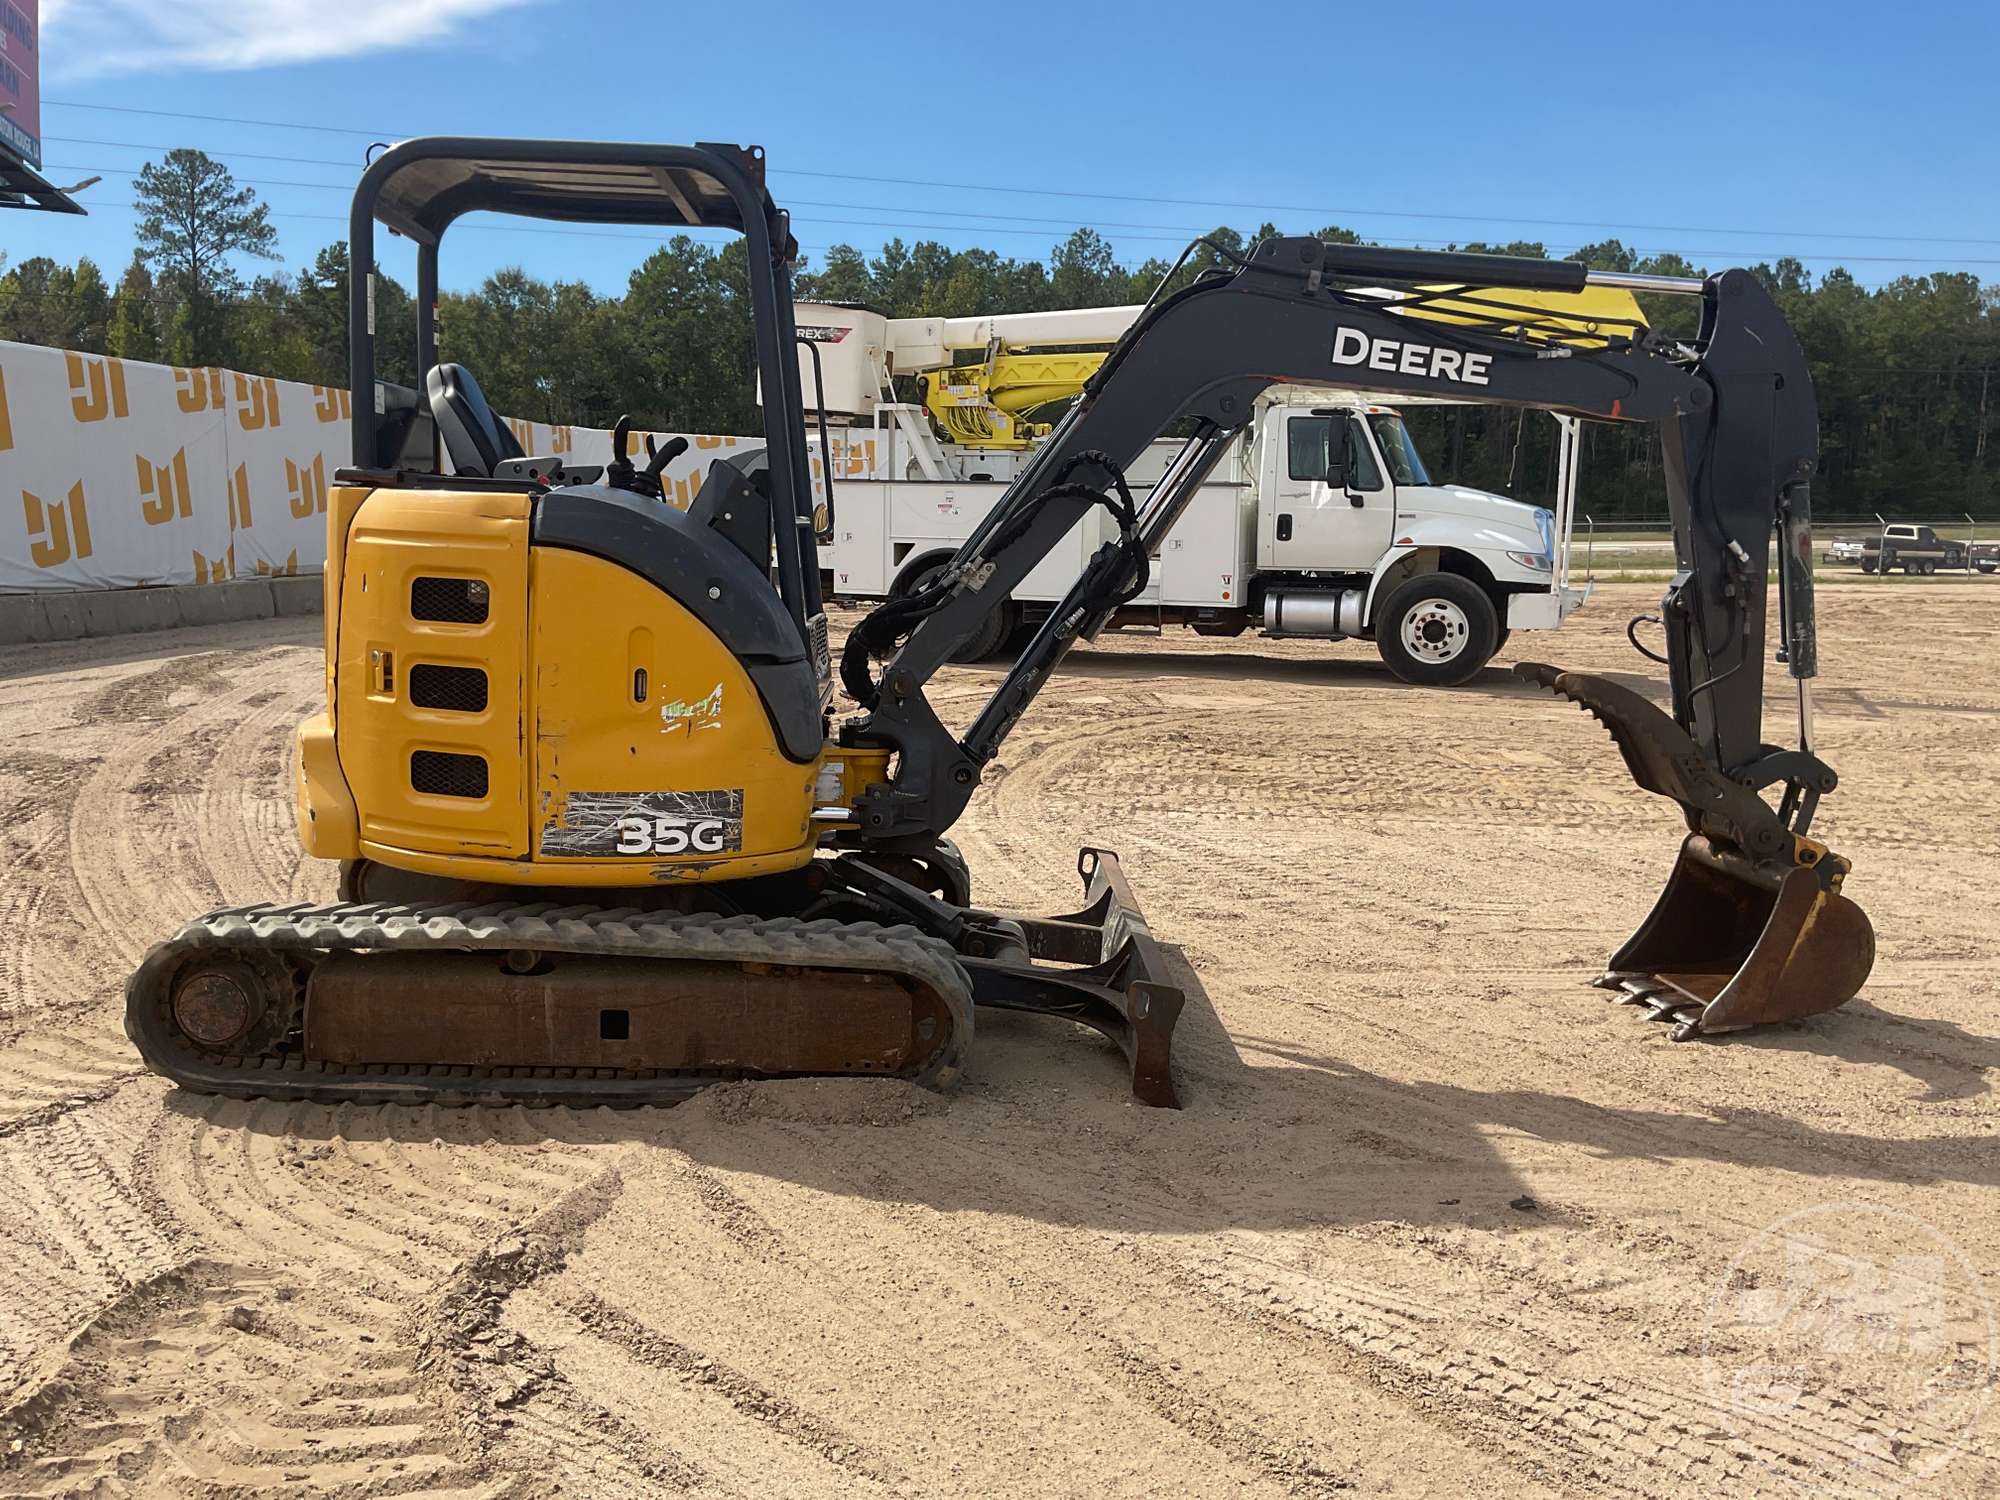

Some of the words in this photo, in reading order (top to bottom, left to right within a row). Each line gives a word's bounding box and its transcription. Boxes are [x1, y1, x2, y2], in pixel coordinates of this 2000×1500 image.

[796, 328, 821, 340] REX
[1332, 326, 1493, 385] DEERE
[616, 817, 723, 854] 35G
